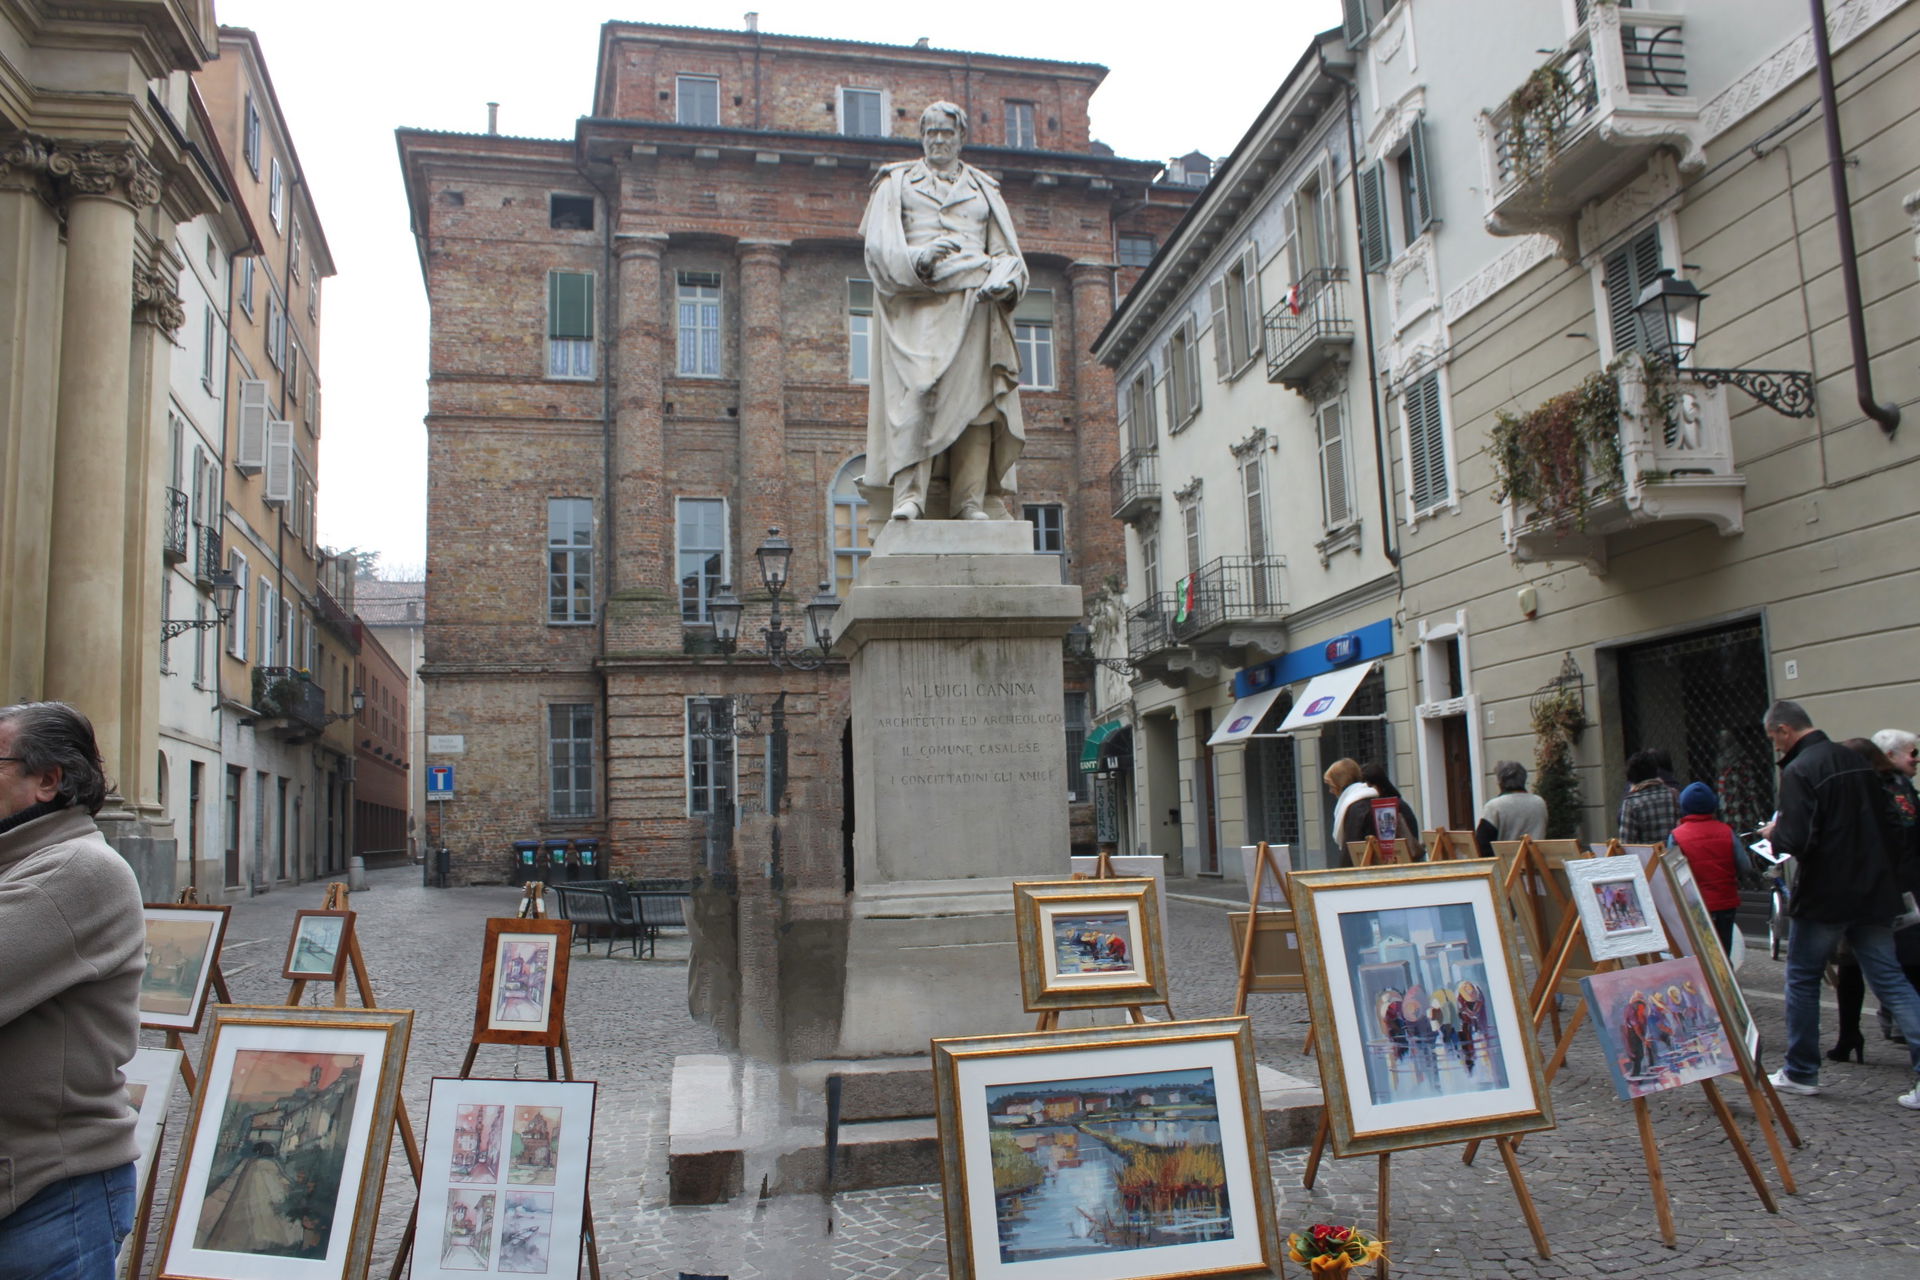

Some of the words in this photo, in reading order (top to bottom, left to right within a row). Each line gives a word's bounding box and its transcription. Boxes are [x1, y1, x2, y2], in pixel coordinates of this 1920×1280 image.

[904, 686, 913, 698] A
[923, 684, 968, 699] LUIGI
[976, 682, 1036, 697] CANINA
[877, 715, 955, 729] ARCHITETTO
[961, 715, 977, 727] ED
[983, 713, 1062, 727] ARCHEOLOGO
[902, 746, 912, 757] IL
[920, 744, 973, 757] COMUNE
[979, 742, 1041, 755] CASALESE
[901, 772, 988, 786] CONCITTADINI
[994, 771, 1012, 783] GLI
[1018, 770, 1053, 783] AMICI
